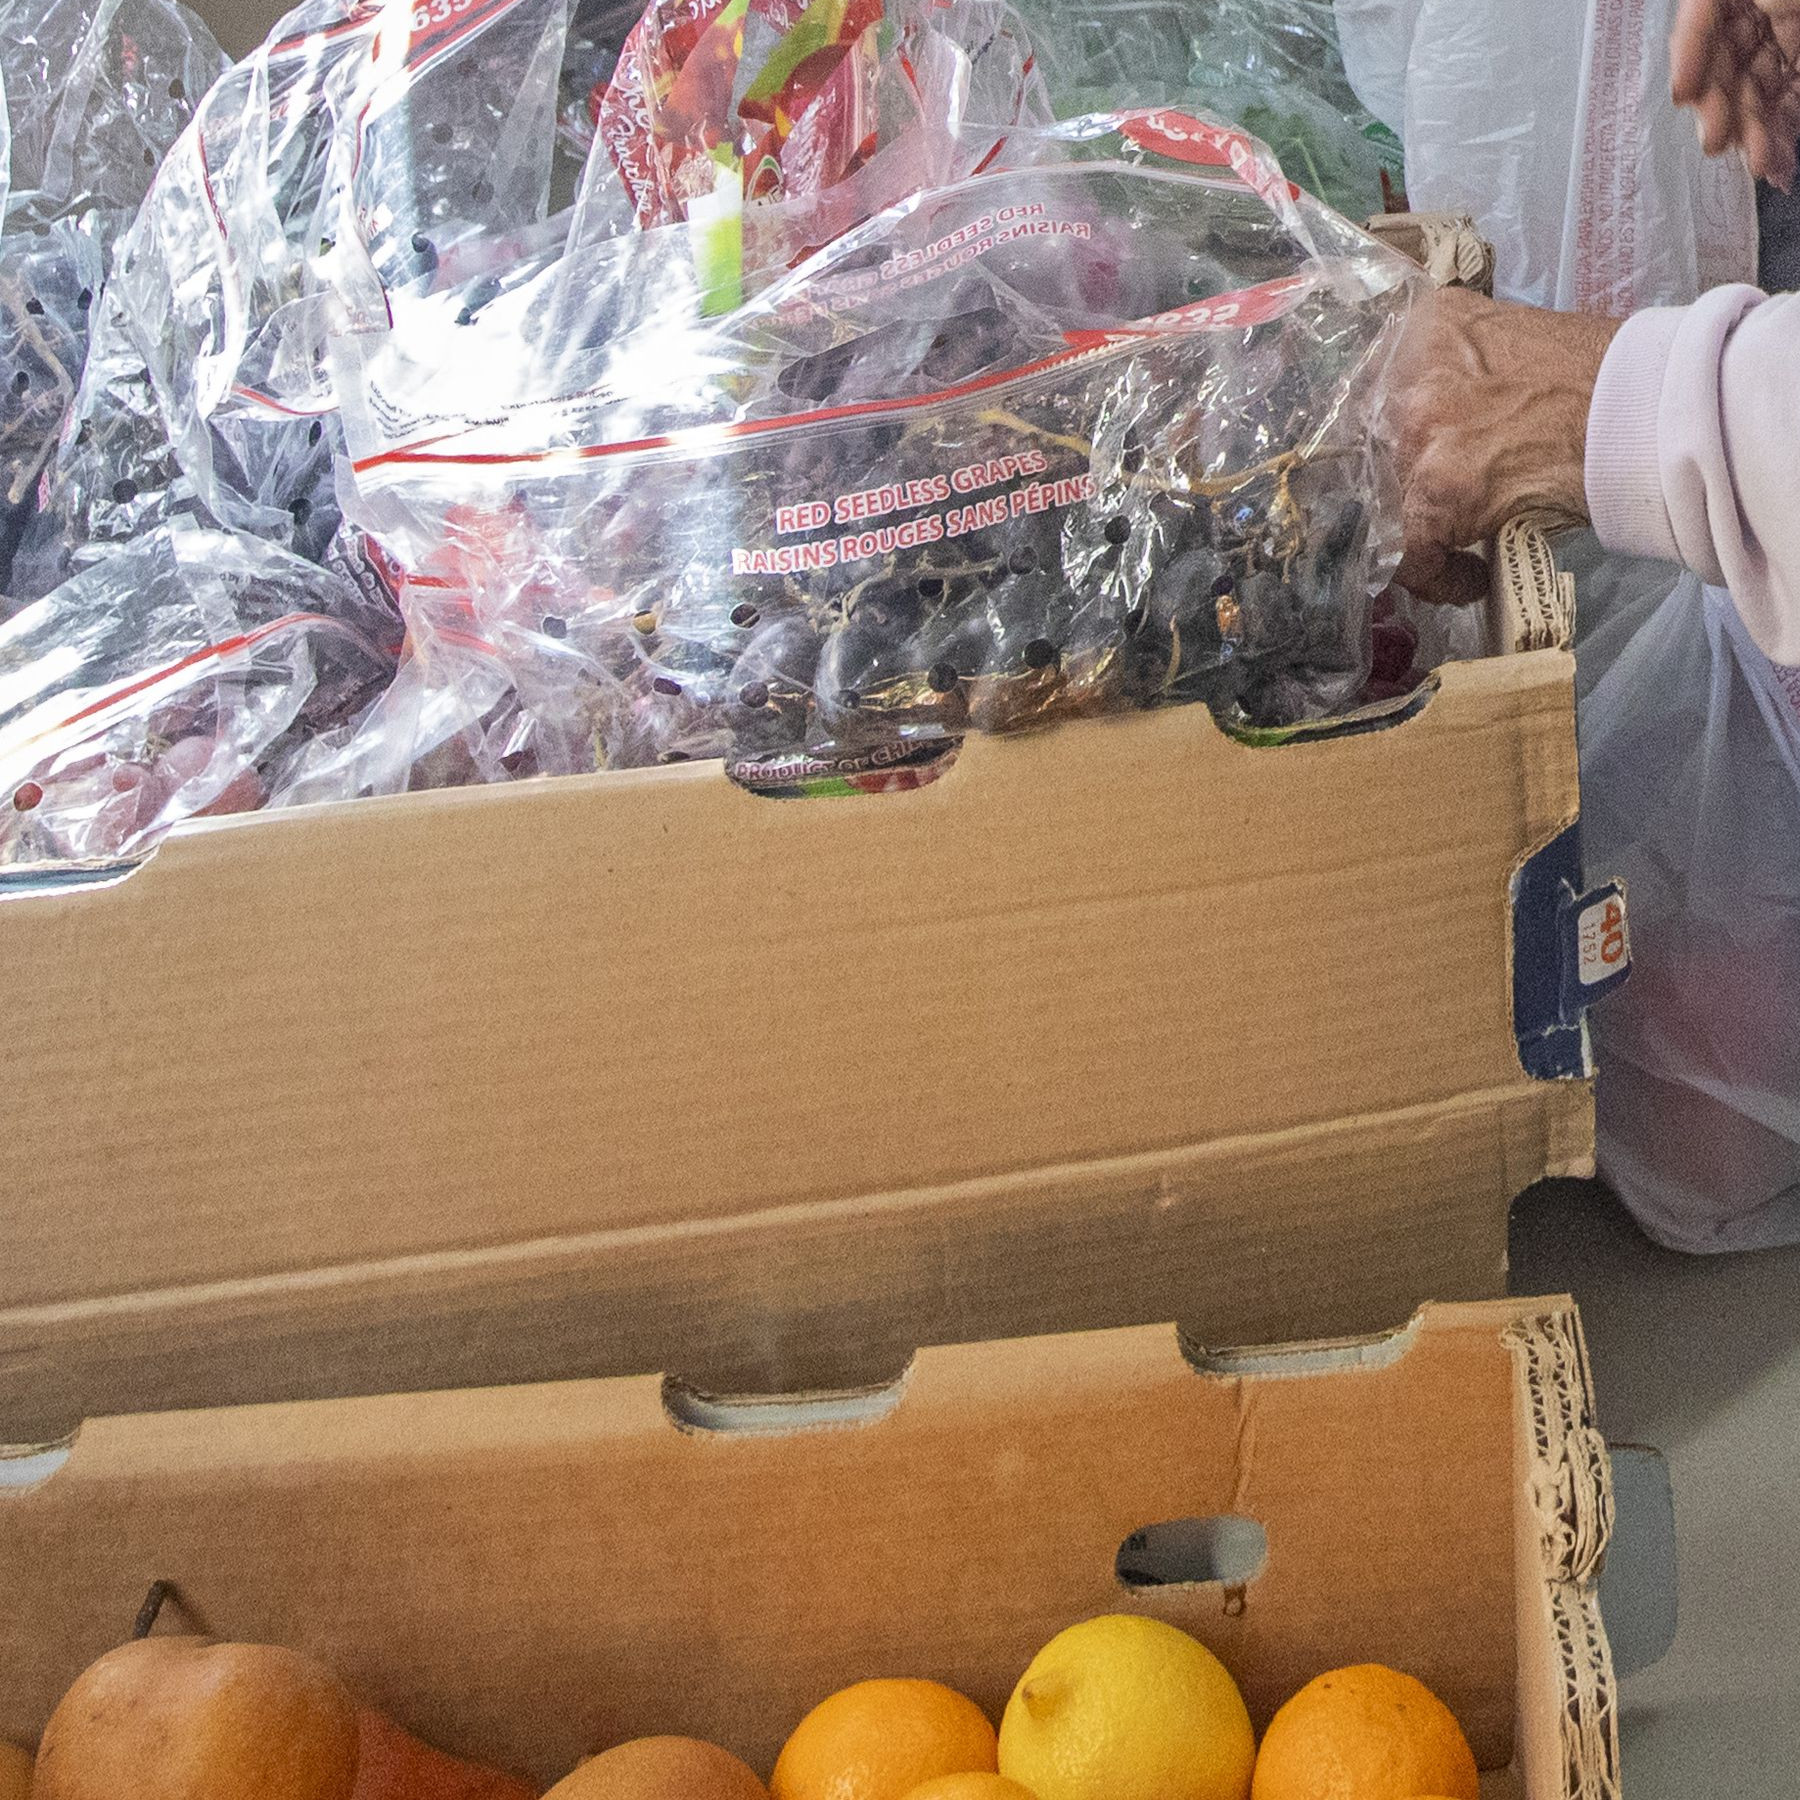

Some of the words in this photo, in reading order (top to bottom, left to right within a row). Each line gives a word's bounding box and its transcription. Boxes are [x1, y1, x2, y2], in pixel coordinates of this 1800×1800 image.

[732, 540, 837, 576] RAISINS
[840, 515, 943, 563] ROUGES
[946, 498, 1008, 537] SANS
[1011, 473, 1097, 519] PÉPINS
[778, 501, 831, 534] RED
[834, 475, 950, 525] SEEDLESS
[951, 450, 1047, 493] GRAPES
[1599, 903, 1623, 964] 40
